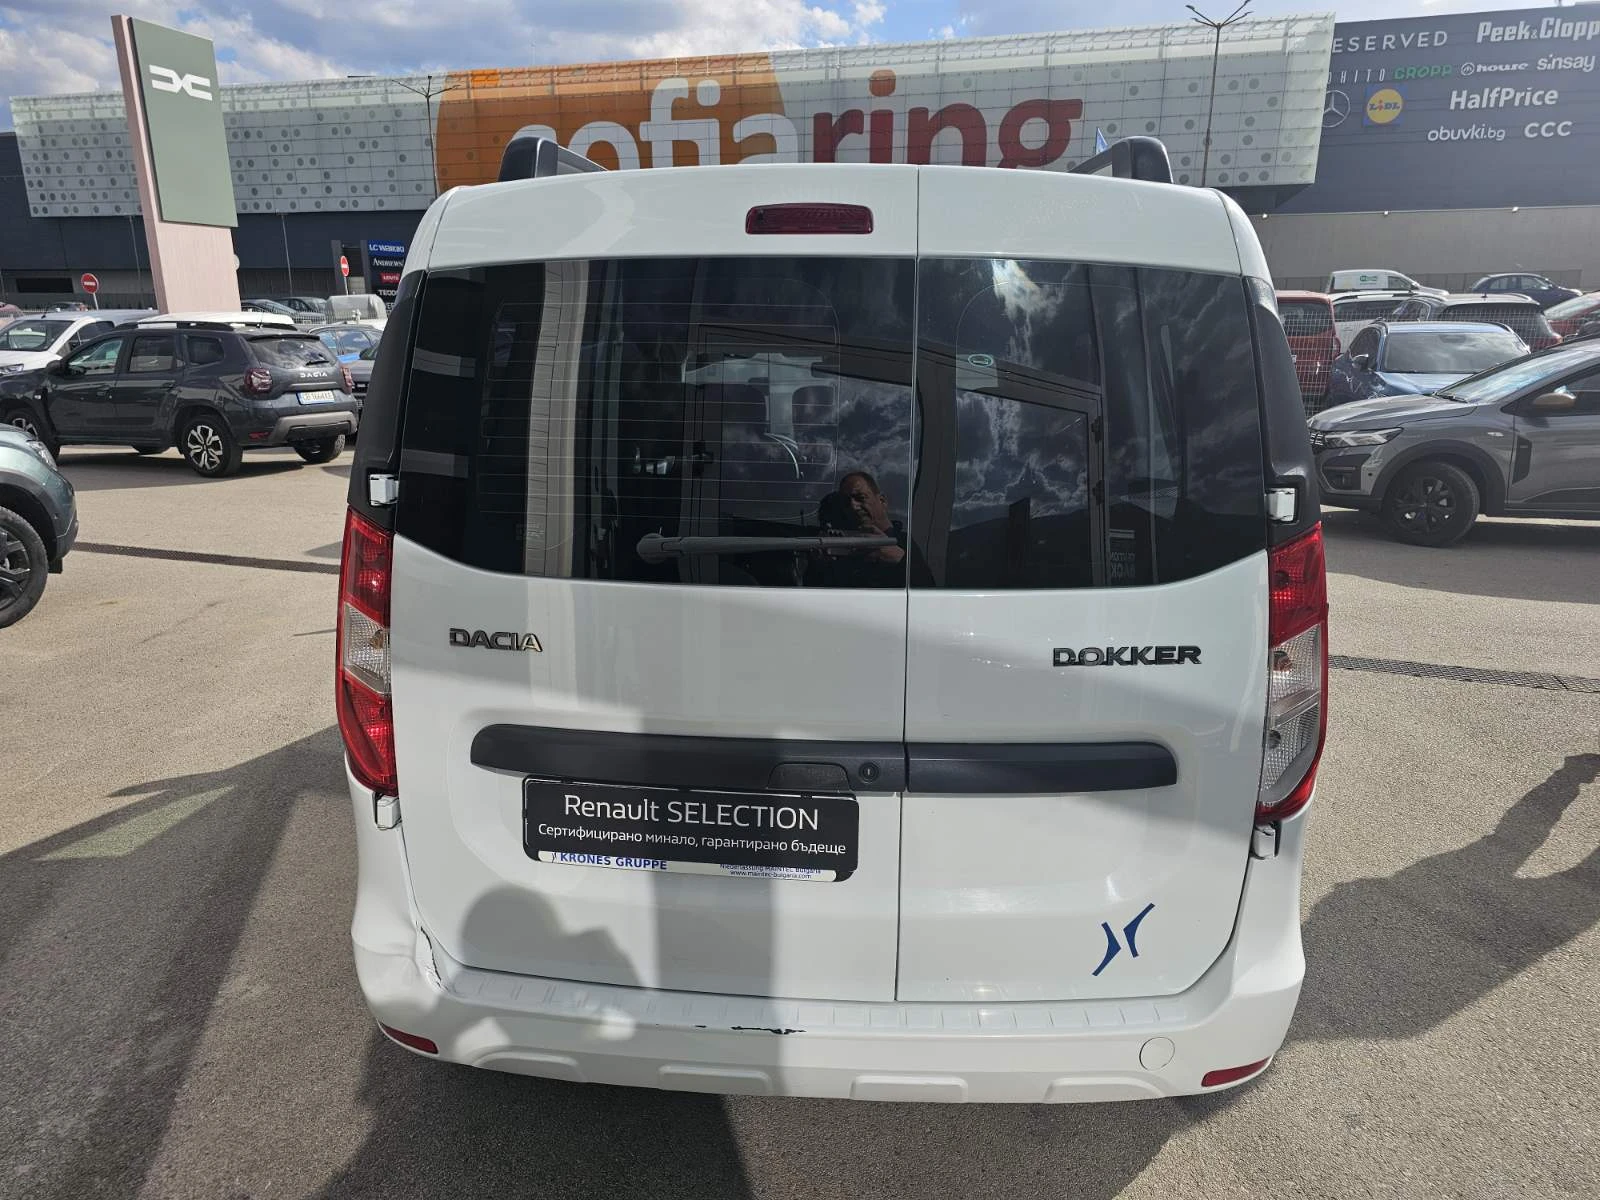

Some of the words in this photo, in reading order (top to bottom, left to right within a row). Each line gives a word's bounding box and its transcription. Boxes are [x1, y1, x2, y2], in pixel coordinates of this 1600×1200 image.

[1394, 65, 1452, 80] CROPP
[1476, 63, 1528, 72] house
[1537, 54, 1596, 72] sinsay
[1450, 87, 1559, 110] HalfPrice
[511, 69, 1083, 169] ofiaring
[1428, 124, 1506, 141] obuvki.bg
[1524, 121, 1573, 138] CCC
[449, 627, 543, 652] DACIA
[1053, 645, 1202, 667] DOKKER
[564, 794, 660, 822] Renault
[667, 801, 818, 831] SELECTION
[538, 823, 643, 843] Сертифицирано
[645, 833, 699, 847] минало,
[701, 836, 788, 852] гарантирано
[791, 839, 846, 855] бъдеще
[560, 852, 611, 866] KRONES
[615, 857, 668, 870] GRUPPE
